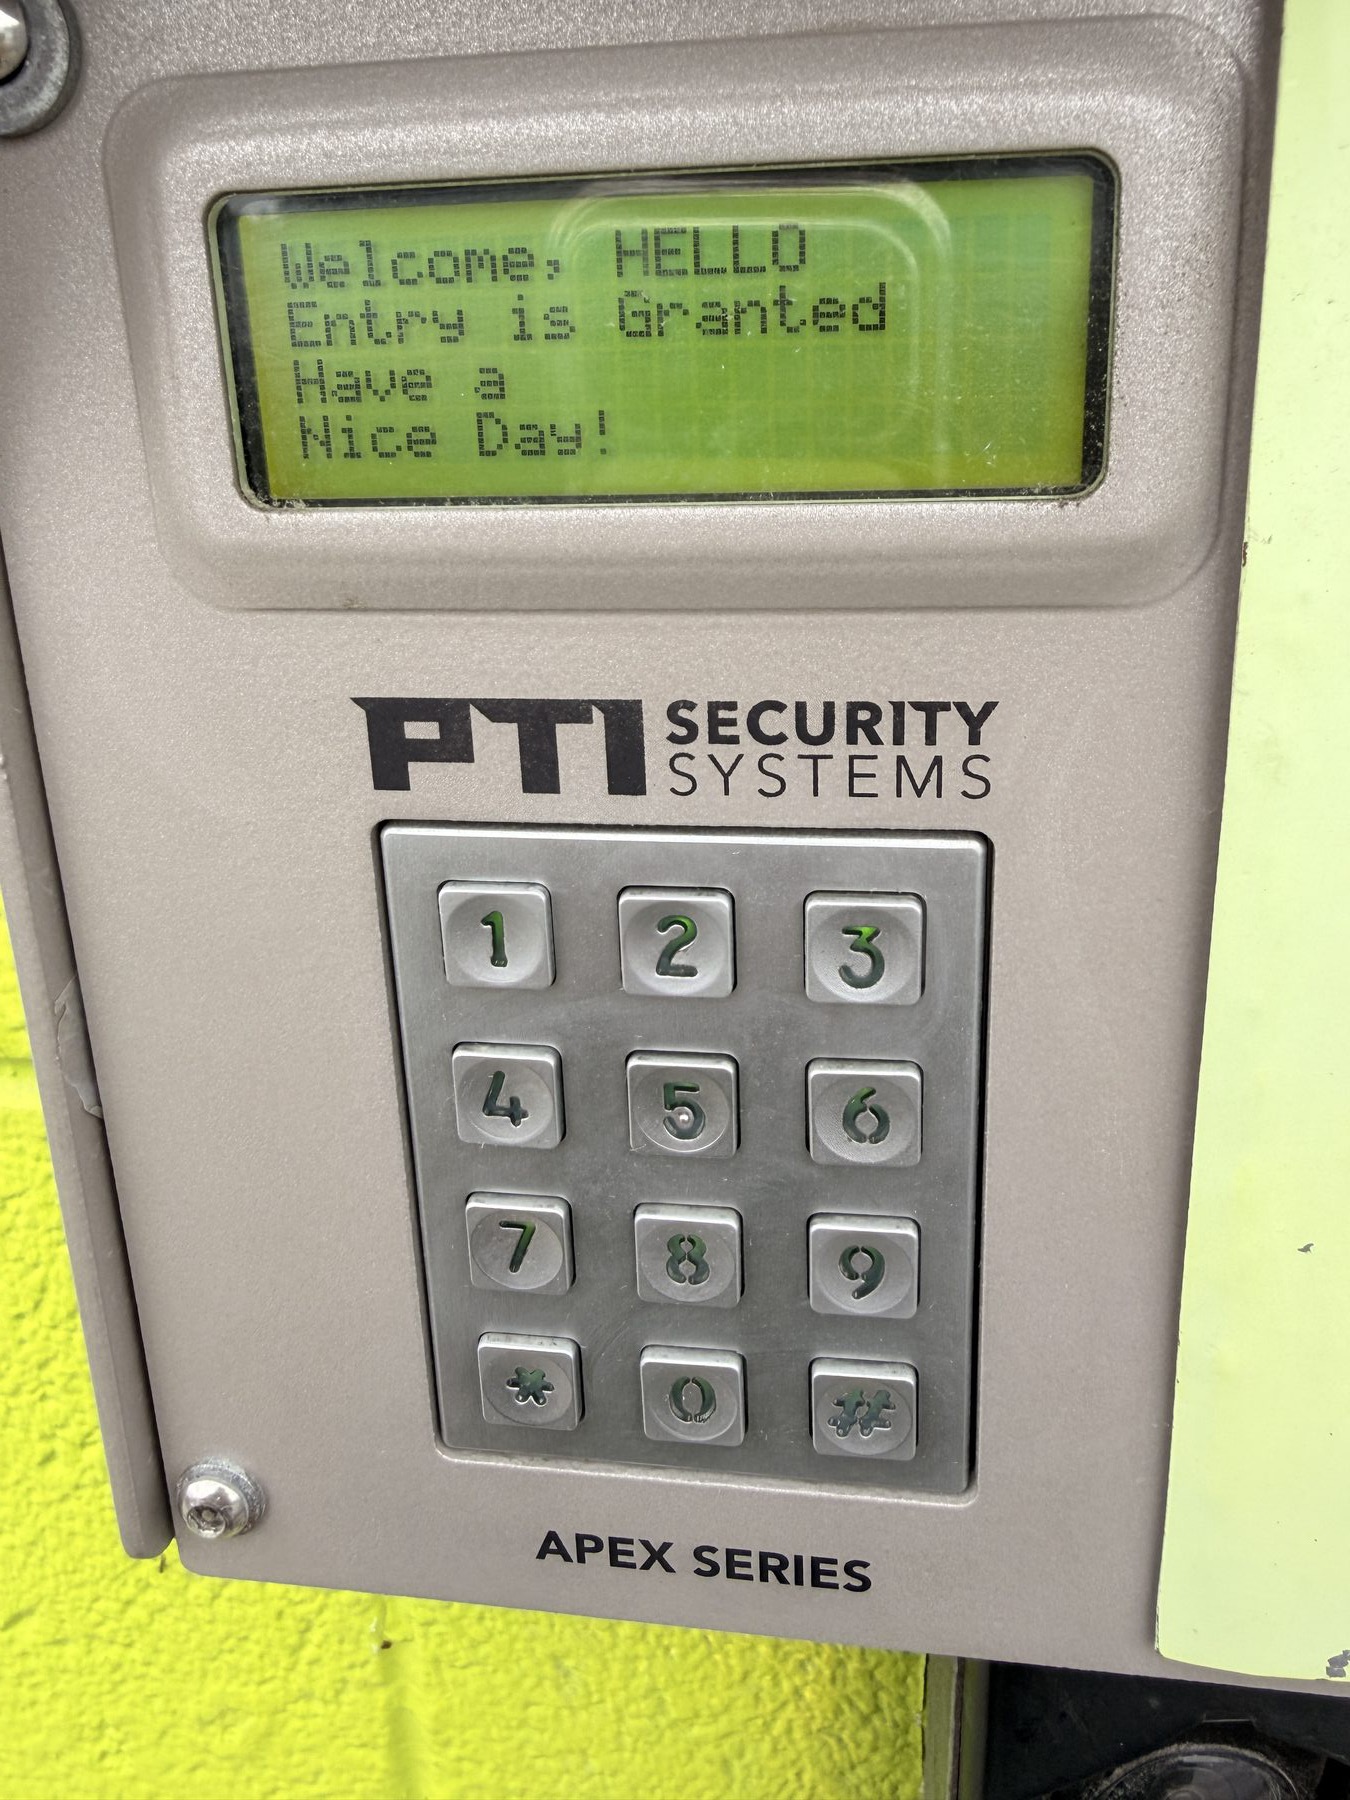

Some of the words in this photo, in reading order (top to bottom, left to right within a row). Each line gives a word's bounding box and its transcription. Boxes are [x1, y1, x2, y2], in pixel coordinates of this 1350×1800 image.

[280, 239, 561, 290] Welcome,
[615, 223, 807, 279] HELLO
[287, 300, 464, 348] Entry
[511, 294, 576, 341] is
[618, 281, 887, 338] Granted
[293, 358, 433, 404] Have
[474, 367, 506, 401] a
[299, 414, 437, 460] Nice
[476, 409, 608, 458] Day!
[351, 697, 648, 797] PTI
[665, 700, 999, 747] SECURITY
[669, 753, 992, 800] SYSTEMS
[480, 911, 509, 968] 1
[655, 914, 699, 978] 2
[838, 925, 886, 990] 3
[482, 1070, 530, 1128] 4
[663, 1081, 706, 1141] 5
[842, 1086, 891, 1145] 6
[498, 1219, 536, 1274] 7
[666, 1233, 710, 1286] 8
[838, 1244, 886, 1301] 9
[535, 1529, 677, 1574] APEX
[692, 1544, 873, 1593] SERIES
